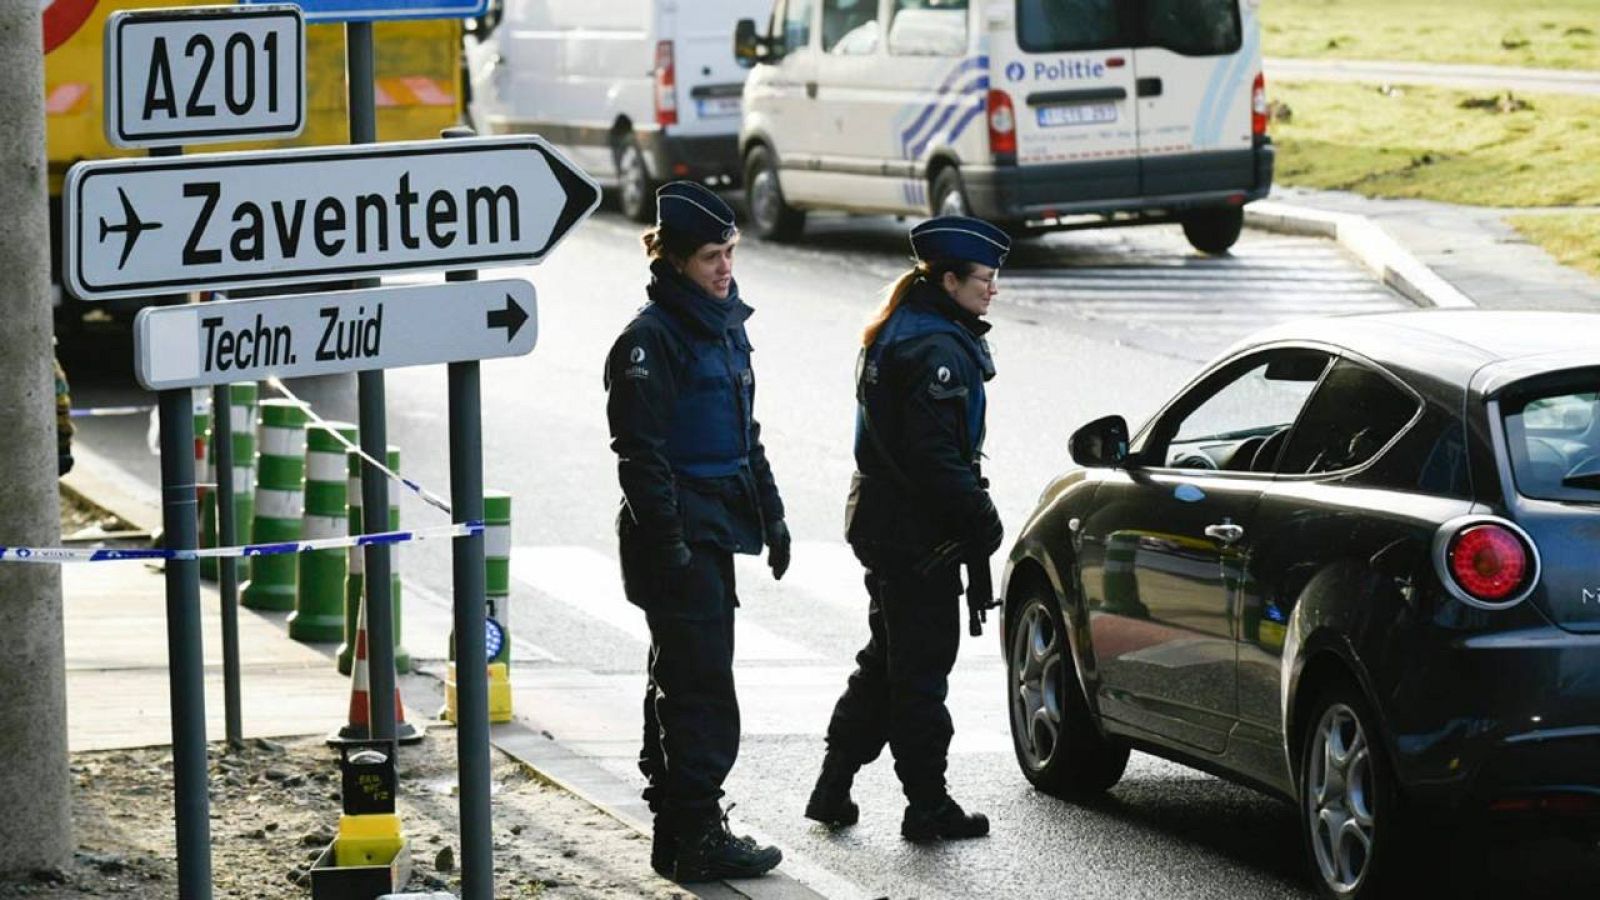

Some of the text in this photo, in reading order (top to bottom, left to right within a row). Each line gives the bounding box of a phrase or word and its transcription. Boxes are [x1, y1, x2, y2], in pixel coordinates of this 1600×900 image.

[142, 31, 278, 121] A201
[1033, 59, 1105, 80] Politie
[182, 171, 520, 266] Zaventem
[201, 303, 383, 372] Techn. Zuid
